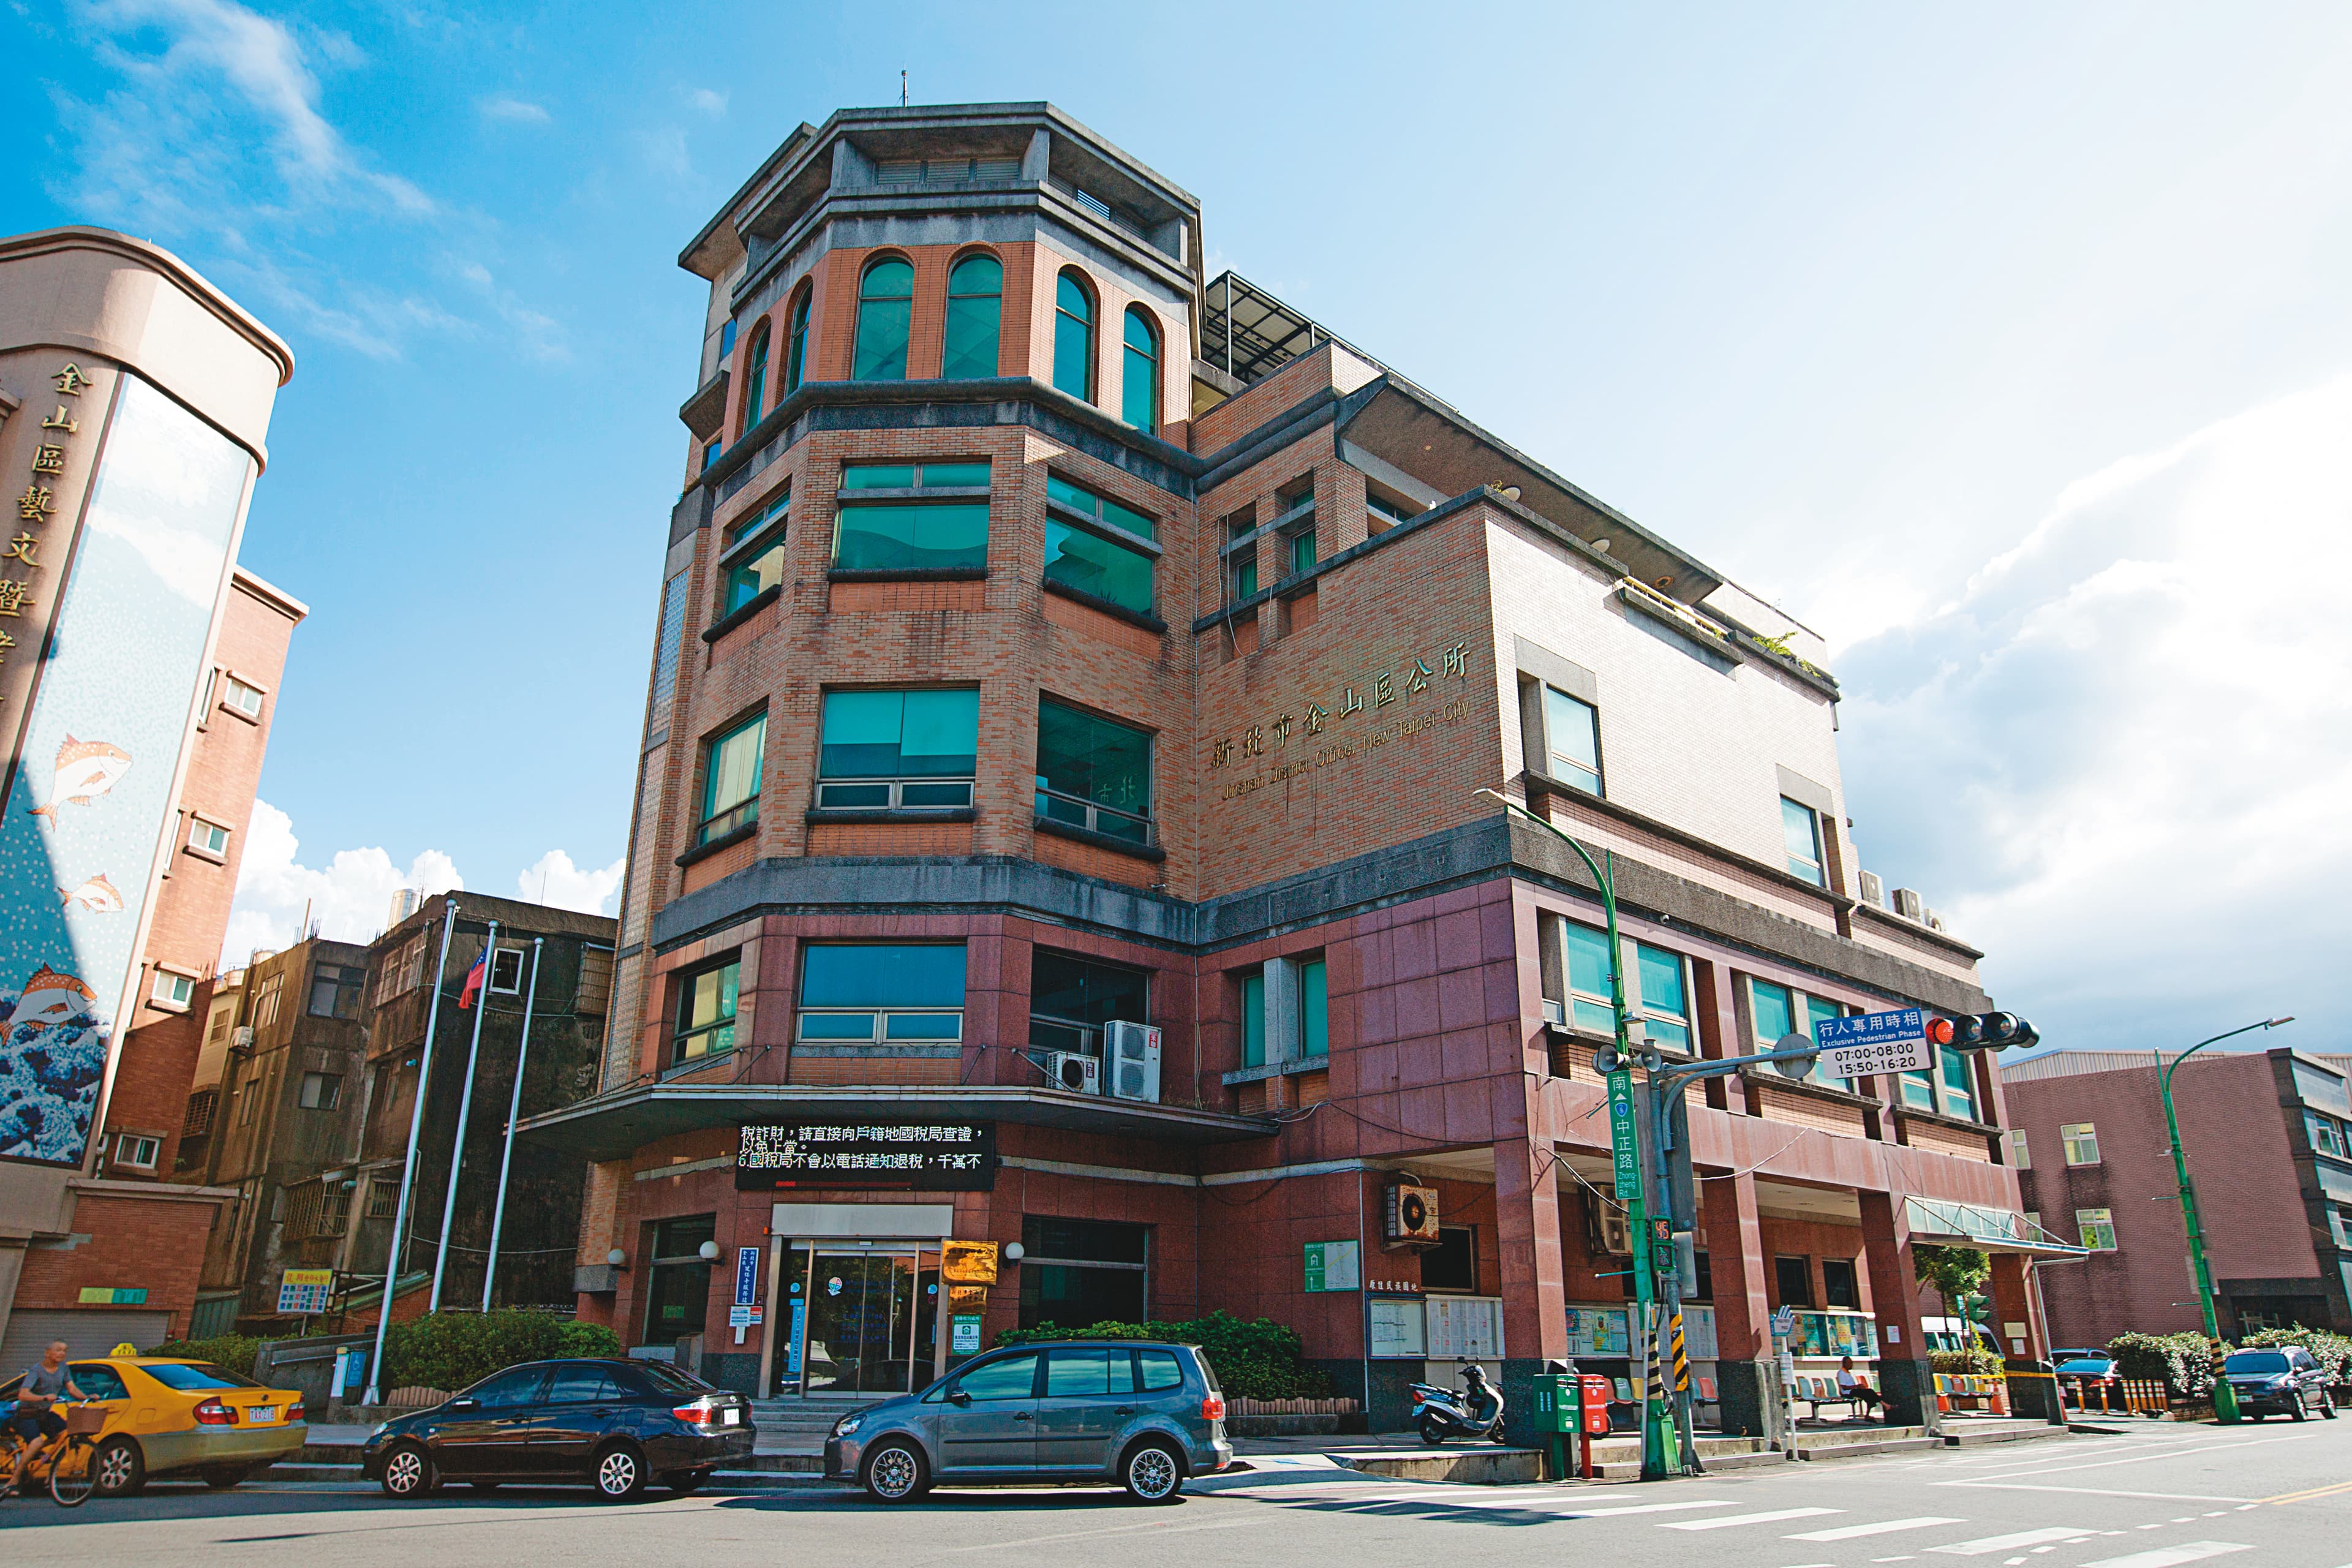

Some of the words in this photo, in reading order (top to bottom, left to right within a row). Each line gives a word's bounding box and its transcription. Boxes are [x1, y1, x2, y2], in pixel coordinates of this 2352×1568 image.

[1211, 641, 1469, 769] 新北市金山區公所
[1222, 775, 1264, 801] Jinshan
[1269, 756, 1310, 784] District
[1363, 728, 1390, 750] New
[1398, 709, 1436, 737] Taipei
[1443, 699, 1469, 721] City
[1819, 1011, 1920, 1038] 行人專用時相
[1822, 1037, 1855, 1048] Exclusive
[1857, 1032, 1896, 1044] Pedestrian
[1898, 1030, 1921, 1039] Phase
[1835, 1043, 1914, 1061] 07:00-08:00
[1839, 1057, 1916, 1074] 15:50-16:20
[1611, 1076, 1626, 1091] 南
[1616, 1119, 1633, 1169] 中正路
